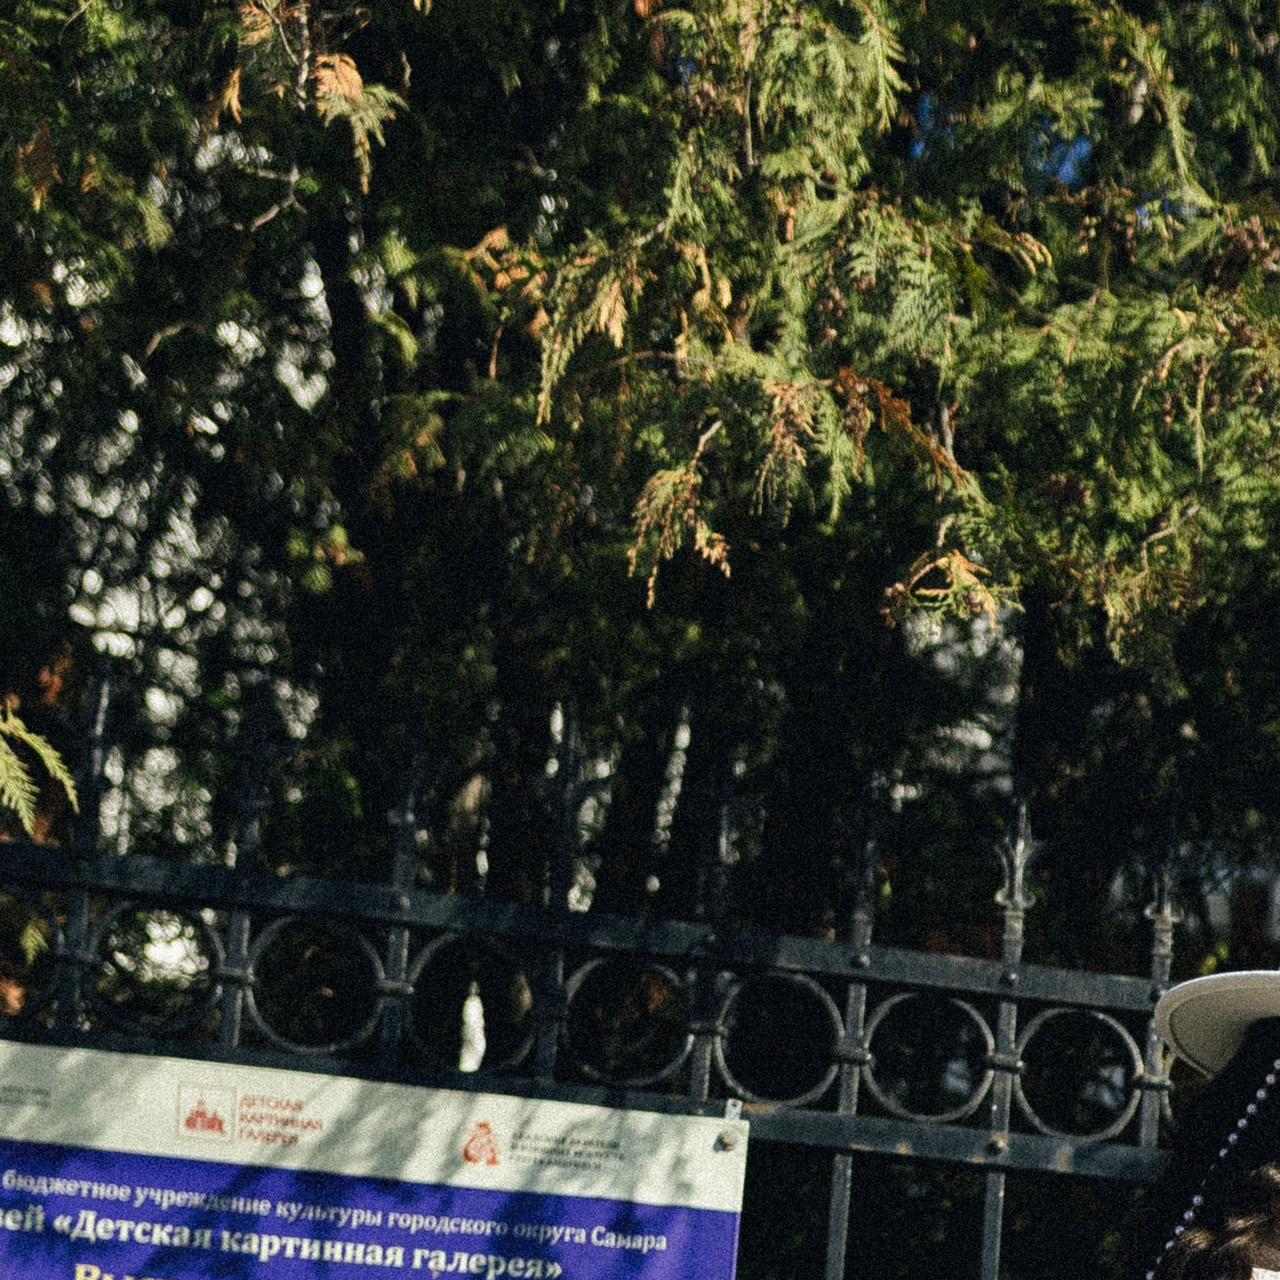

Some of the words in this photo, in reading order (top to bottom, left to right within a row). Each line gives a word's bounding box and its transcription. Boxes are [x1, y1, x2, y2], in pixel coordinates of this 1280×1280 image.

[0, 1203, 44, 1232] ей
[53, 1209, 212, 1249] «Детская
[221, 1229, 404, 1267] картинная
[2, 1169, 131, 1202] бюджетное
[135, 1186, 271, 1215] учреждение
[275, 1202, 382, 1229] культуры
[387, 1210, 507, 1238] городского
[513, 1222, 585, 1246] округа
[591, 1226, 667, 1254] Самара
